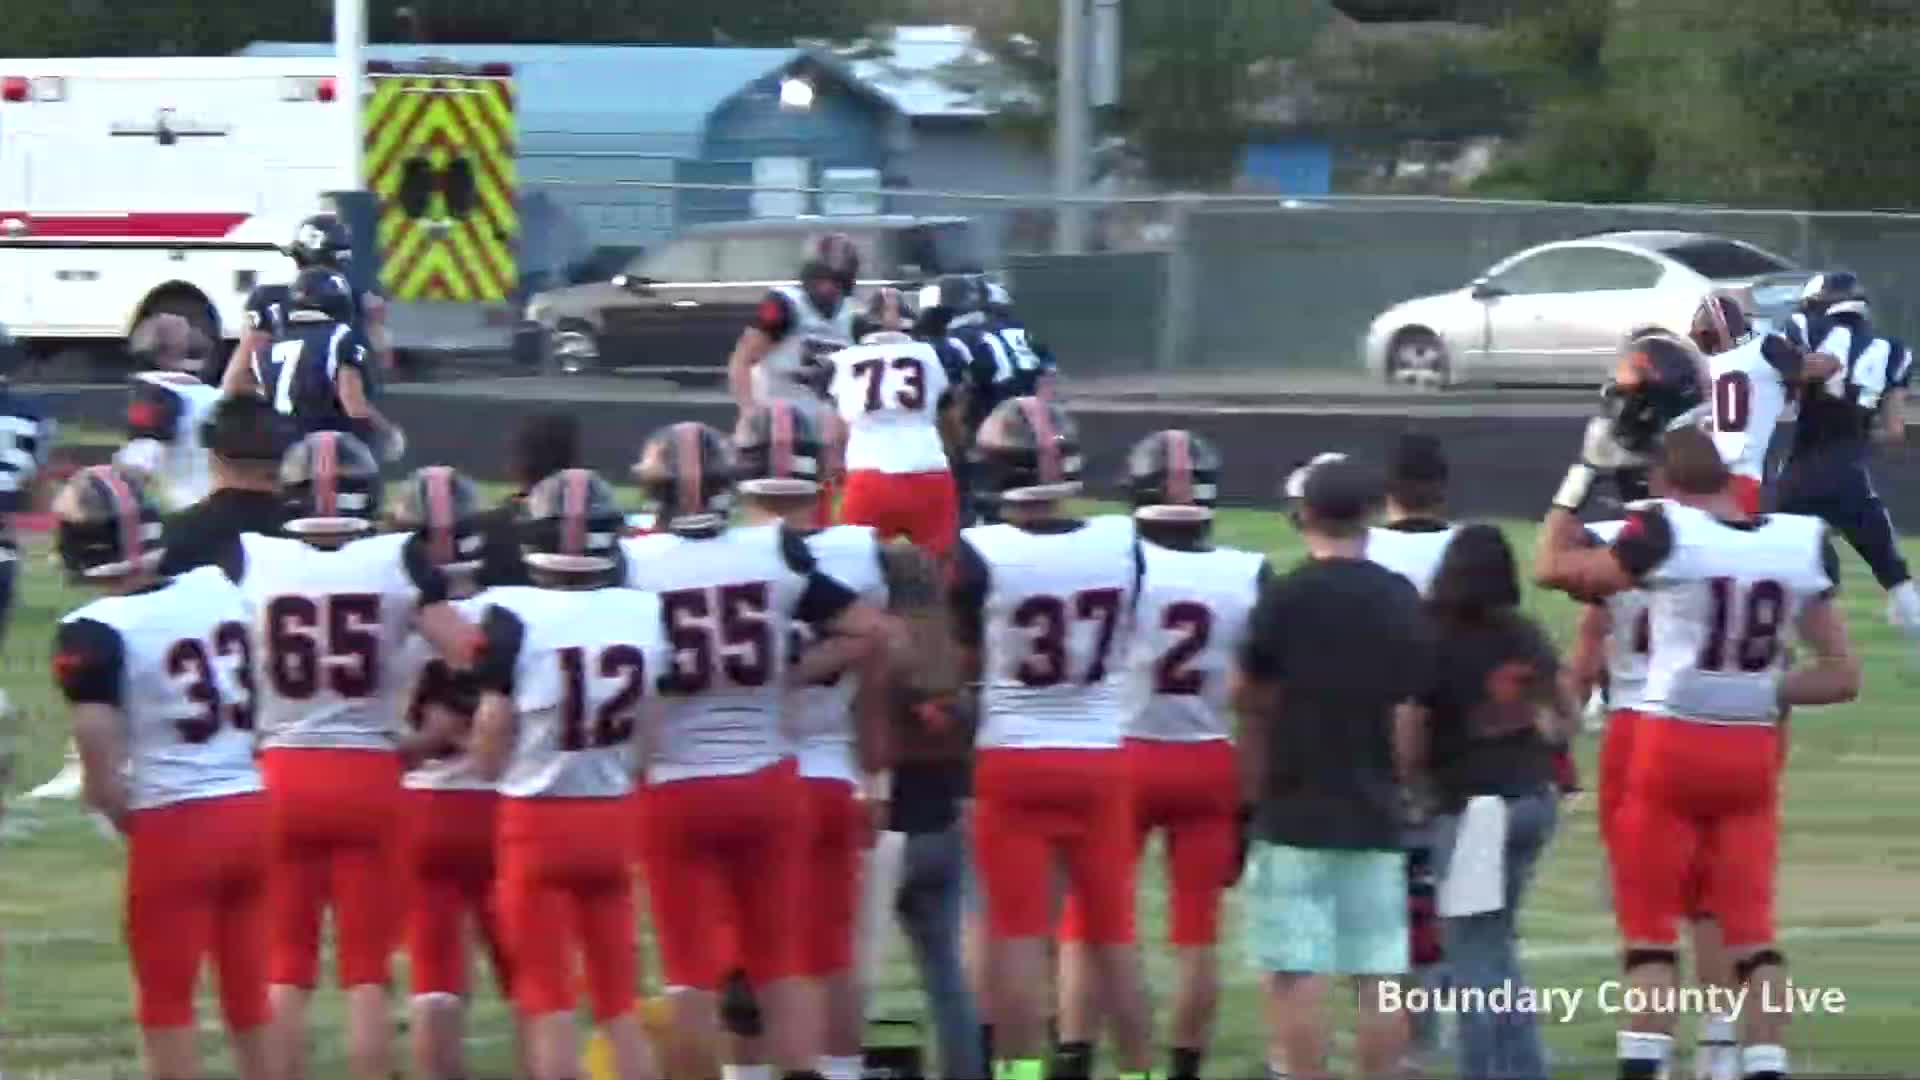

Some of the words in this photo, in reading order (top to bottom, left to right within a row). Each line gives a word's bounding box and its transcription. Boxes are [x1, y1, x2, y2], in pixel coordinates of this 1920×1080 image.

[271, 340, 304, 415] 7
[852, 357, 926, 412] 73
[268, 593, 380, 700] 65
[657, 580, 775, 693] 55
[1014, 587, 1124, 686] 37
[1153, 601, 1212, 695] 2
[1698, 576, 1785, 672] 18
[166, 620, 254, 744] 33
[557, 644, 644, 751] 12
